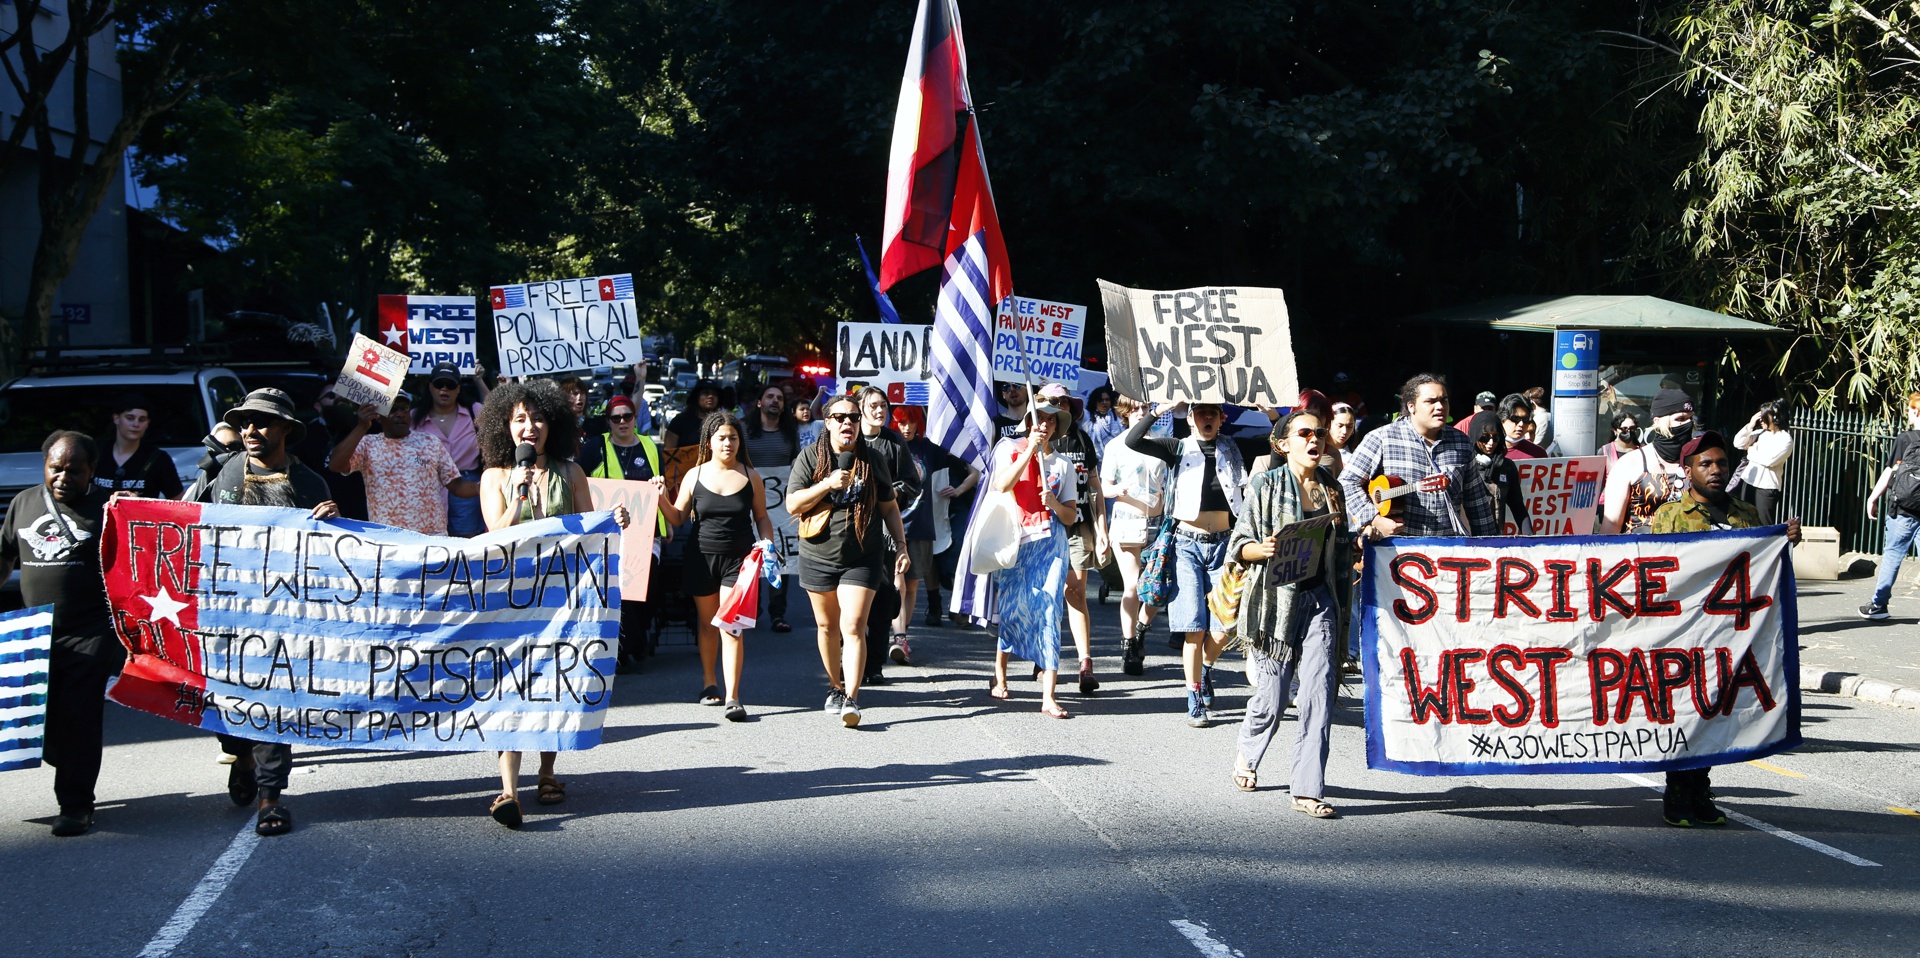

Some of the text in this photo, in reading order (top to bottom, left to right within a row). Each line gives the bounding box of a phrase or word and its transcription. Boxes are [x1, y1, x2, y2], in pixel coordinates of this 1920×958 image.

[527, 278, 599, 308] FREE
[1152, 289, 1240, 325] FREE
[65, 307, 86, 320] 32
[407, 304, 476, 321] FREE
[495, 302, 639, 350] POLITCAL
[1041, 303, 1074, 321] WEST
[408, 328, 476, 345] WEST
[839, 325, 918, 379] LAND
[996, 333, 1082, 362] POLITICAL
[1139, 323, 1263, 367] WEST
[408, 351, 476, 368] PAPUA
[506, 338, 626, 375] PRISONERS
[994, 353, 1080, 381] PRISONERS
[346, 387, 375, 405] HAND
[1138, 364, 1278, 405] PAPUA
[1518, 460, 1579, 493] FREE
[128, 520, 609, 611] FREE WEST PAPUAN
[1271, 559, 1308, 586] SALE
[1389, 551, 1773, 631] STRIKE 4
[368, 639, 609, 706] PRISONERS
[1400, 643, 1777, 729] WEST PAPUA
